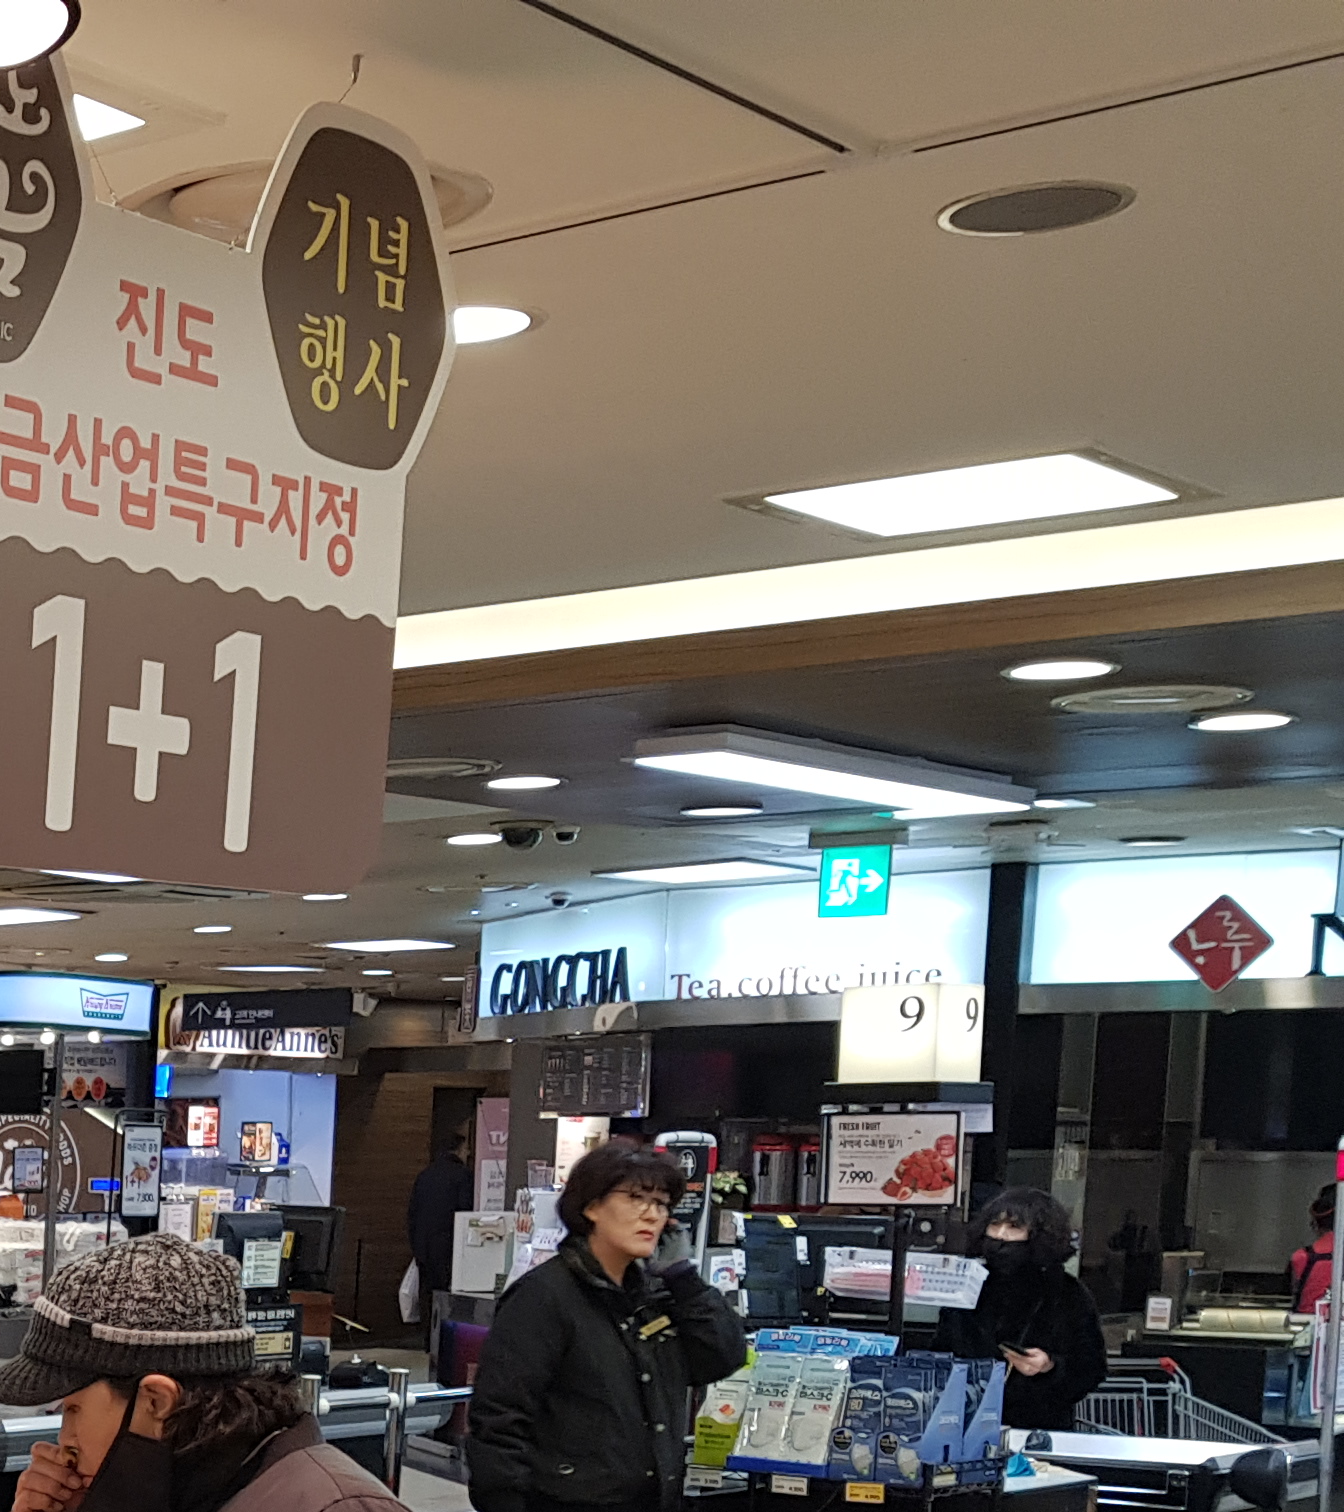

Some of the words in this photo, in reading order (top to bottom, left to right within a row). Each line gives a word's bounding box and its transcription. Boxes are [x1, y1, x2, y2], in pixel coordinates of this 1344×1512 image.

[303, 192, 409, 313] 기념
[115, 278, 219, 388] 진도
[299, 313, 410, 431] 행사
[31, 593, 263, 853] 1+1
[898, 996, 925, 1033] 9
[965, 997, 979, 1033] 9
[838, 1171, 874, 1184] 7,990
